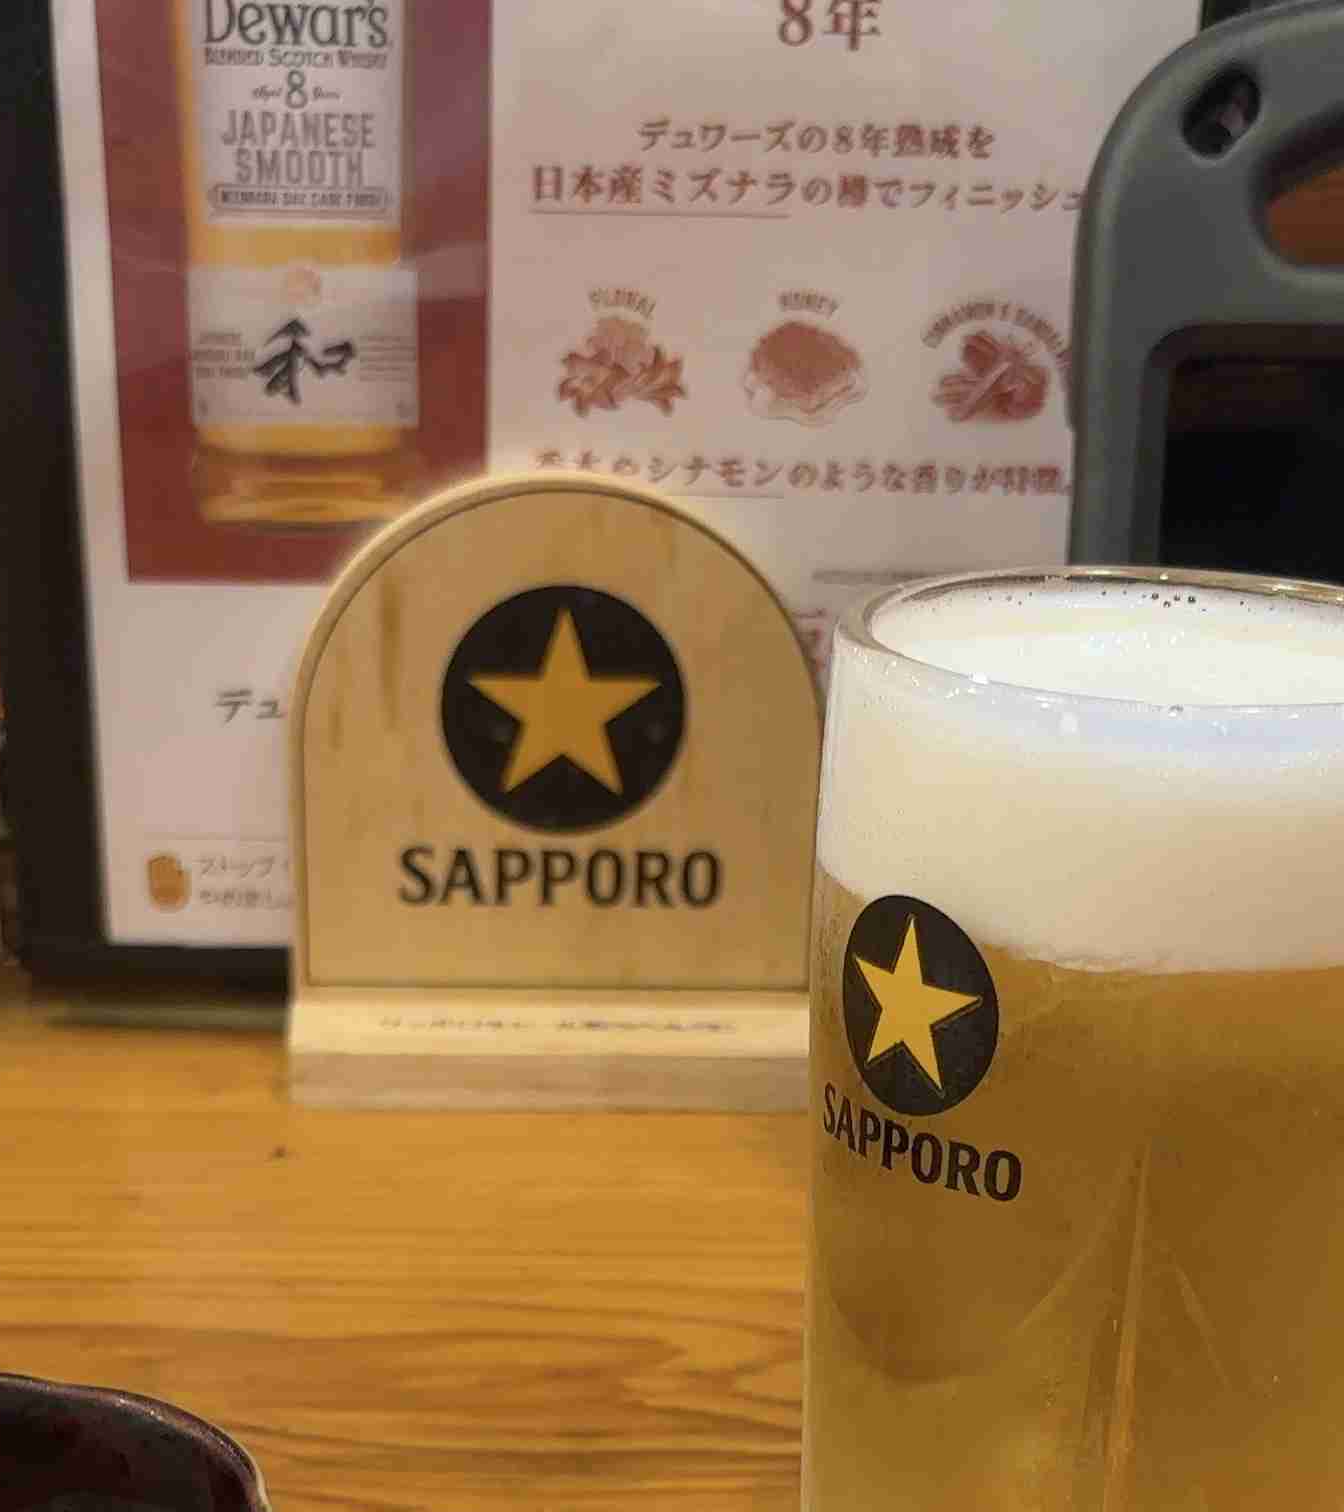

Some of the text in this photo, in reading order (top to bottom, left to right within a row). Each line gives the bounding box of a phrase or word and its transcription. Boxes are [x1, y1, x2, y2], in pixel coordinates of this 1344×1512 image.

[204, 0, 388, 48] Dewar's
[268, 48, 334, 68] SCOTCH
[285, 69, 307, 109] 8
[221, 110, 376, 148] JAPANESE
[637, 118, 996, 160] デュワーズの8年熟成を
[235, 148, 365, 186] SMOOTH
[254, 318, 357, 404] 和
[398, 845, 723, 910] SAPPORO
[822, 1081, 1022, 1202] SAPPORO
